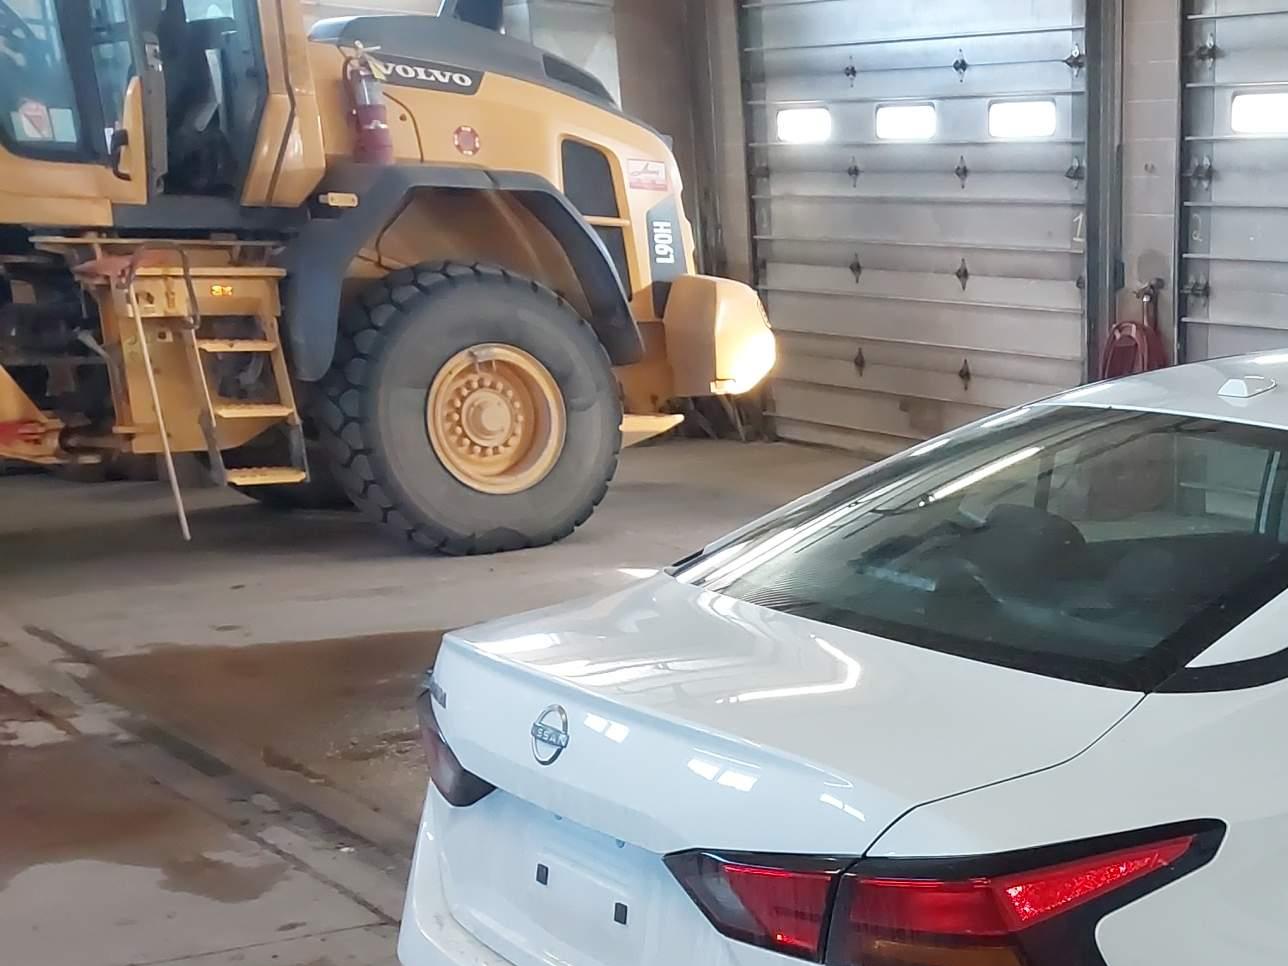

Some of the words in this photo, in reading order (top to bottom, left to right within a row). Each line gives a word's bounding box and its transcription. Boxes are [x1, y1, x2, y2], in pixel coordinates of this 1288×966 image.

[383, 62, 472, 87] VOLVO
[1073, 212, 1085, 242] 1
[652, 221, 675, 264] L90H
[531, 724, 569, 748] SSAN
